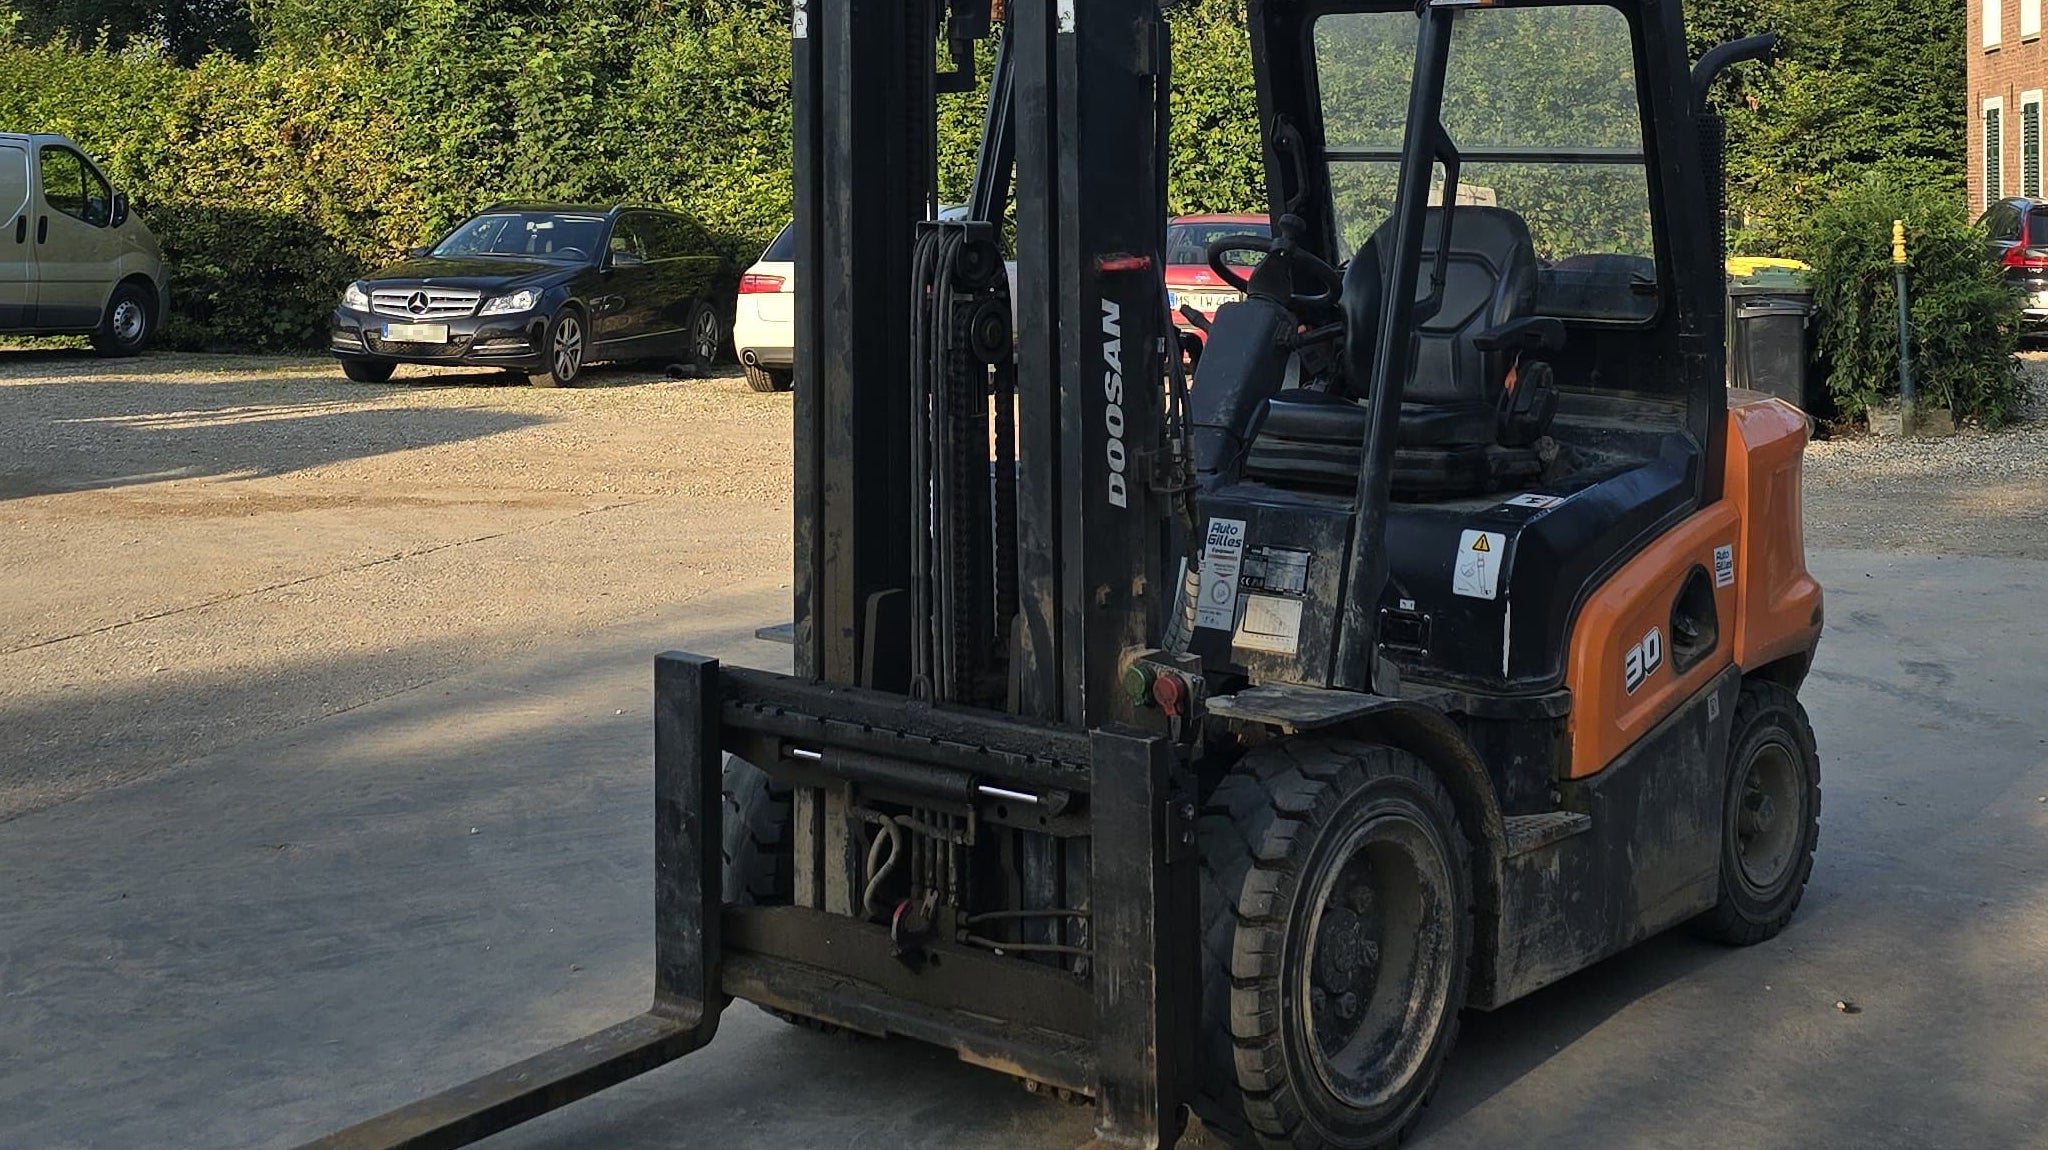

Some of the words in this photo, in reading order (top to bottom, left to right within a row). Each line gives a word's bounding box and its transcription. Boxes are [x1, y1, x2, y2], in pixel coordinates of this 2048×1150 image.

[1101, 298, 1127, 508] DOOSAN
[1211, 522, 1238, 535] Auto
[1207, 534, 1243, 548] Gilles
[1716, 550, 1730, 560] Auto
[1626, 627, 1663, 695] 30
